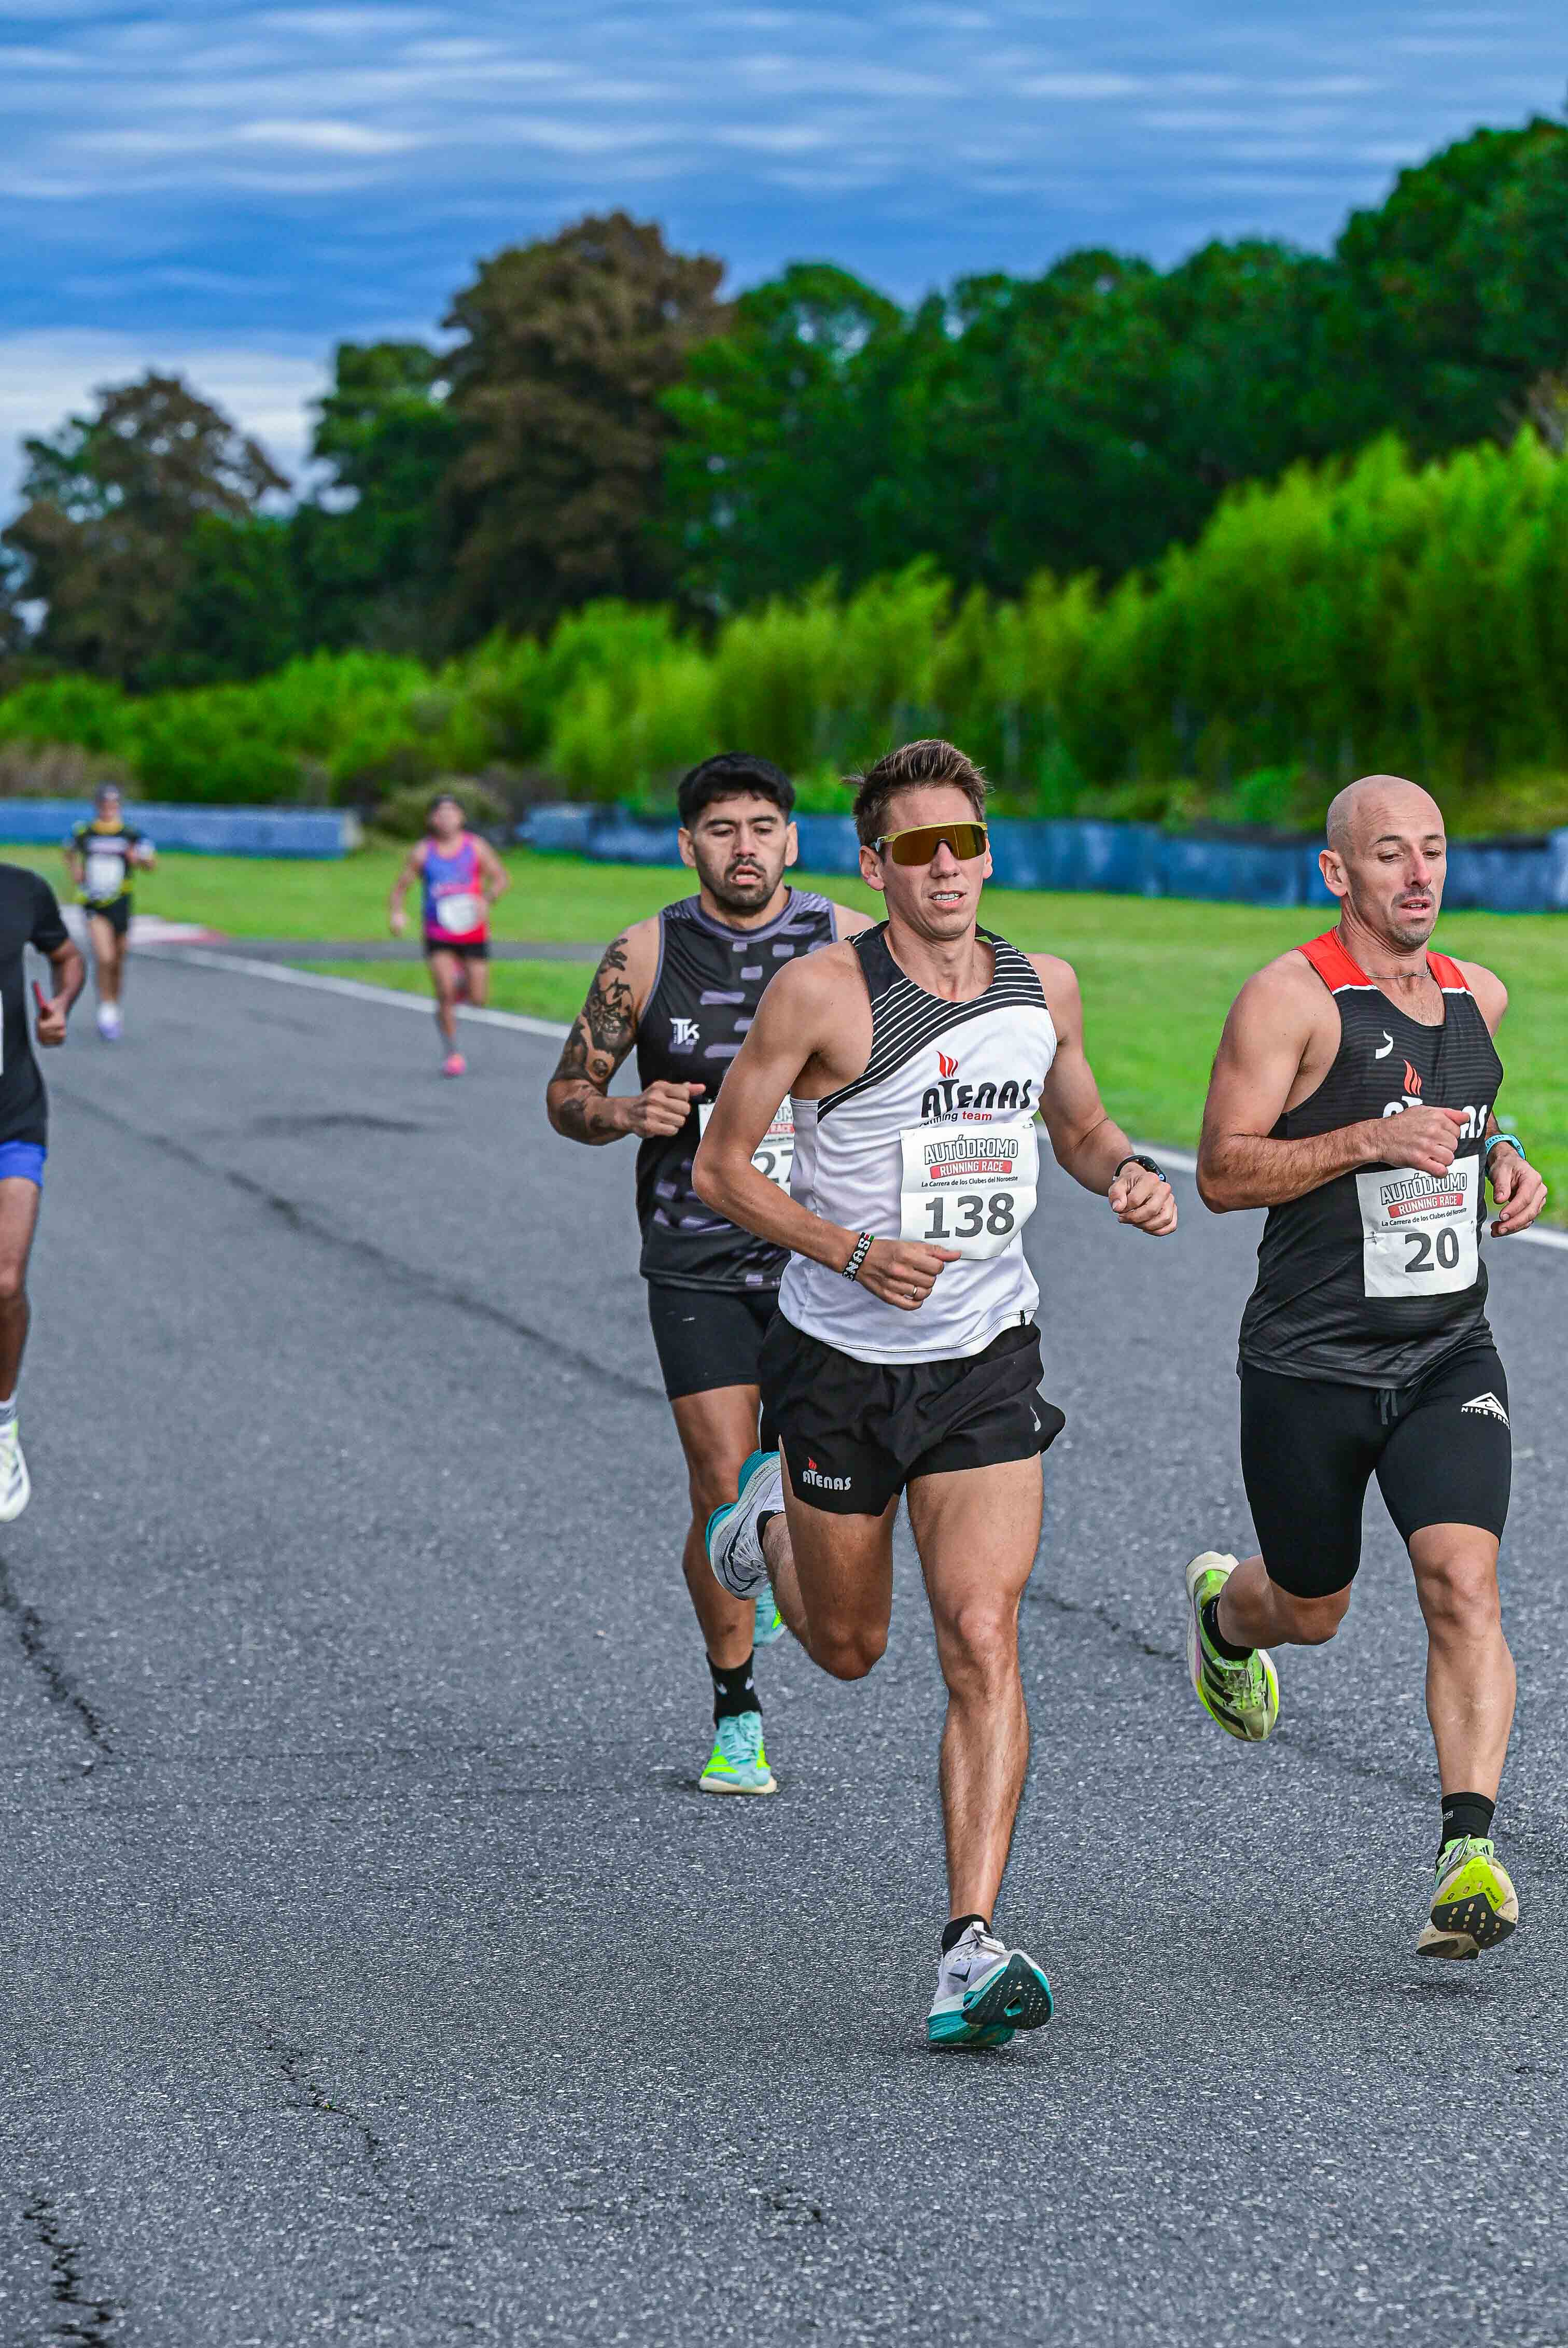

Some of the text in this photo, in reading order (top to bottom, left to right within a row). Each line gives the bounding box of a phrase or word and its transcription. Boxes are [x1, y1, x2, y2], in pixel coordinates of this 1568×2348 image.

[921, 1079, 1032, 1118] ATENAS
[962, 1111, 992, 1121] team
[925, 1134, 1018, 1165] AUTÓDROMO
[940, 1161, 1004, 1177] RUNNING RACE
[1380, 1173, 1467, 1205] AUTÓDROMO
[925, 1193, 1014, 1239] 138
[1398, 1195, 1457, 1215] RUNNING RACE
[1405, 1227, 1459, 1273] 20
[1461, 1407, 1488, 1415] NIKE
[803, 1470, 851, 1490] ATENAS
